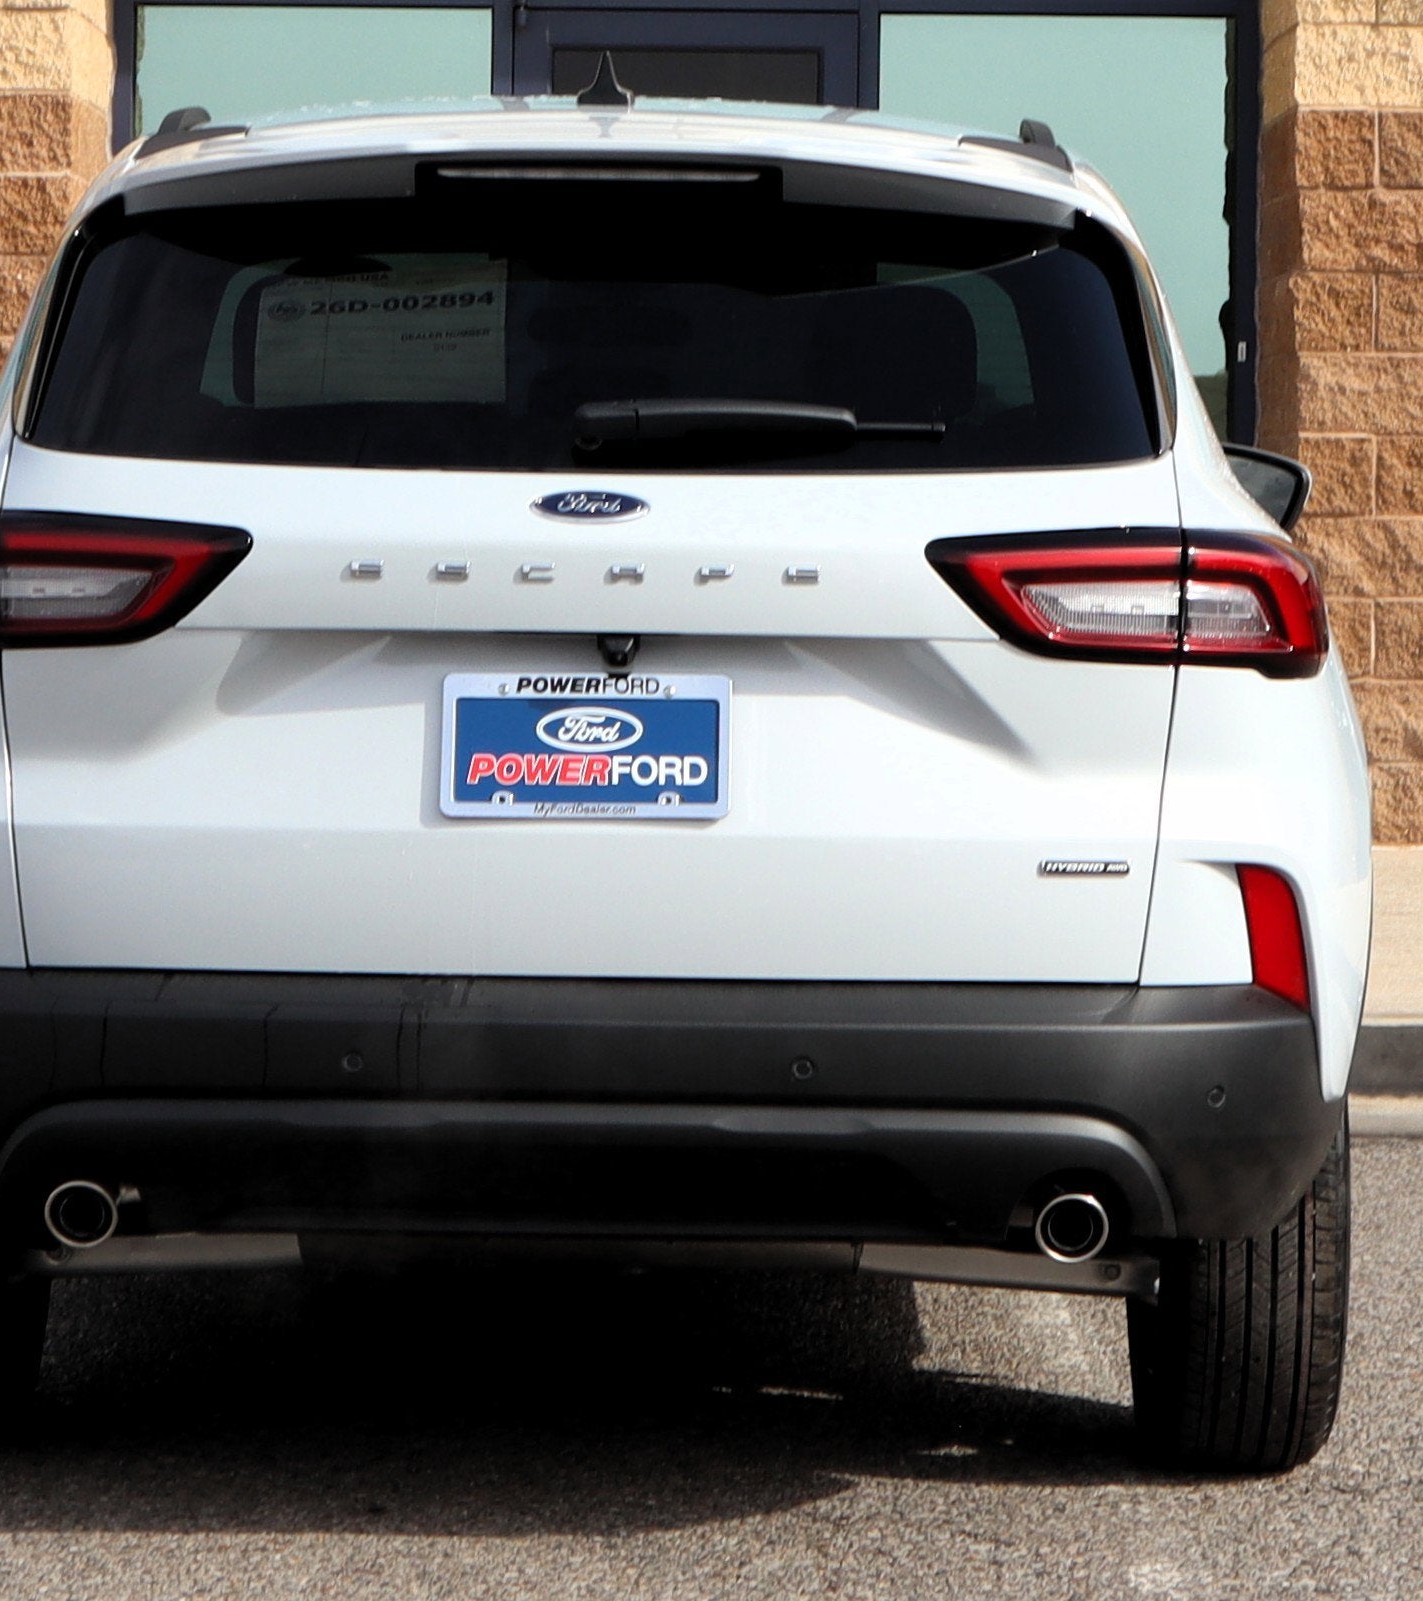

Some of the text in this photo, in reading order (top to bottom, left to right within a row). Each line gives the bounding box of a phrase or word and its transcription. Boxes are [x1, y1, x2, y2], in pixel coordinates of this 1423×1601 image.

[400, 328, 491, 342] DEALER NUMBER
[557, 493, 622, 514] Ford
[348, 558, 823, 584] ESCAPE
[516, 676, 660, 696] POWERFORD
[557, 715, 621, 744] Ford
[467, 753, 709, 787] POWERFORD
[534, 801, 636, 818] MyFordDealer.com
[1045, 862, 1105, 873] HYBRID
